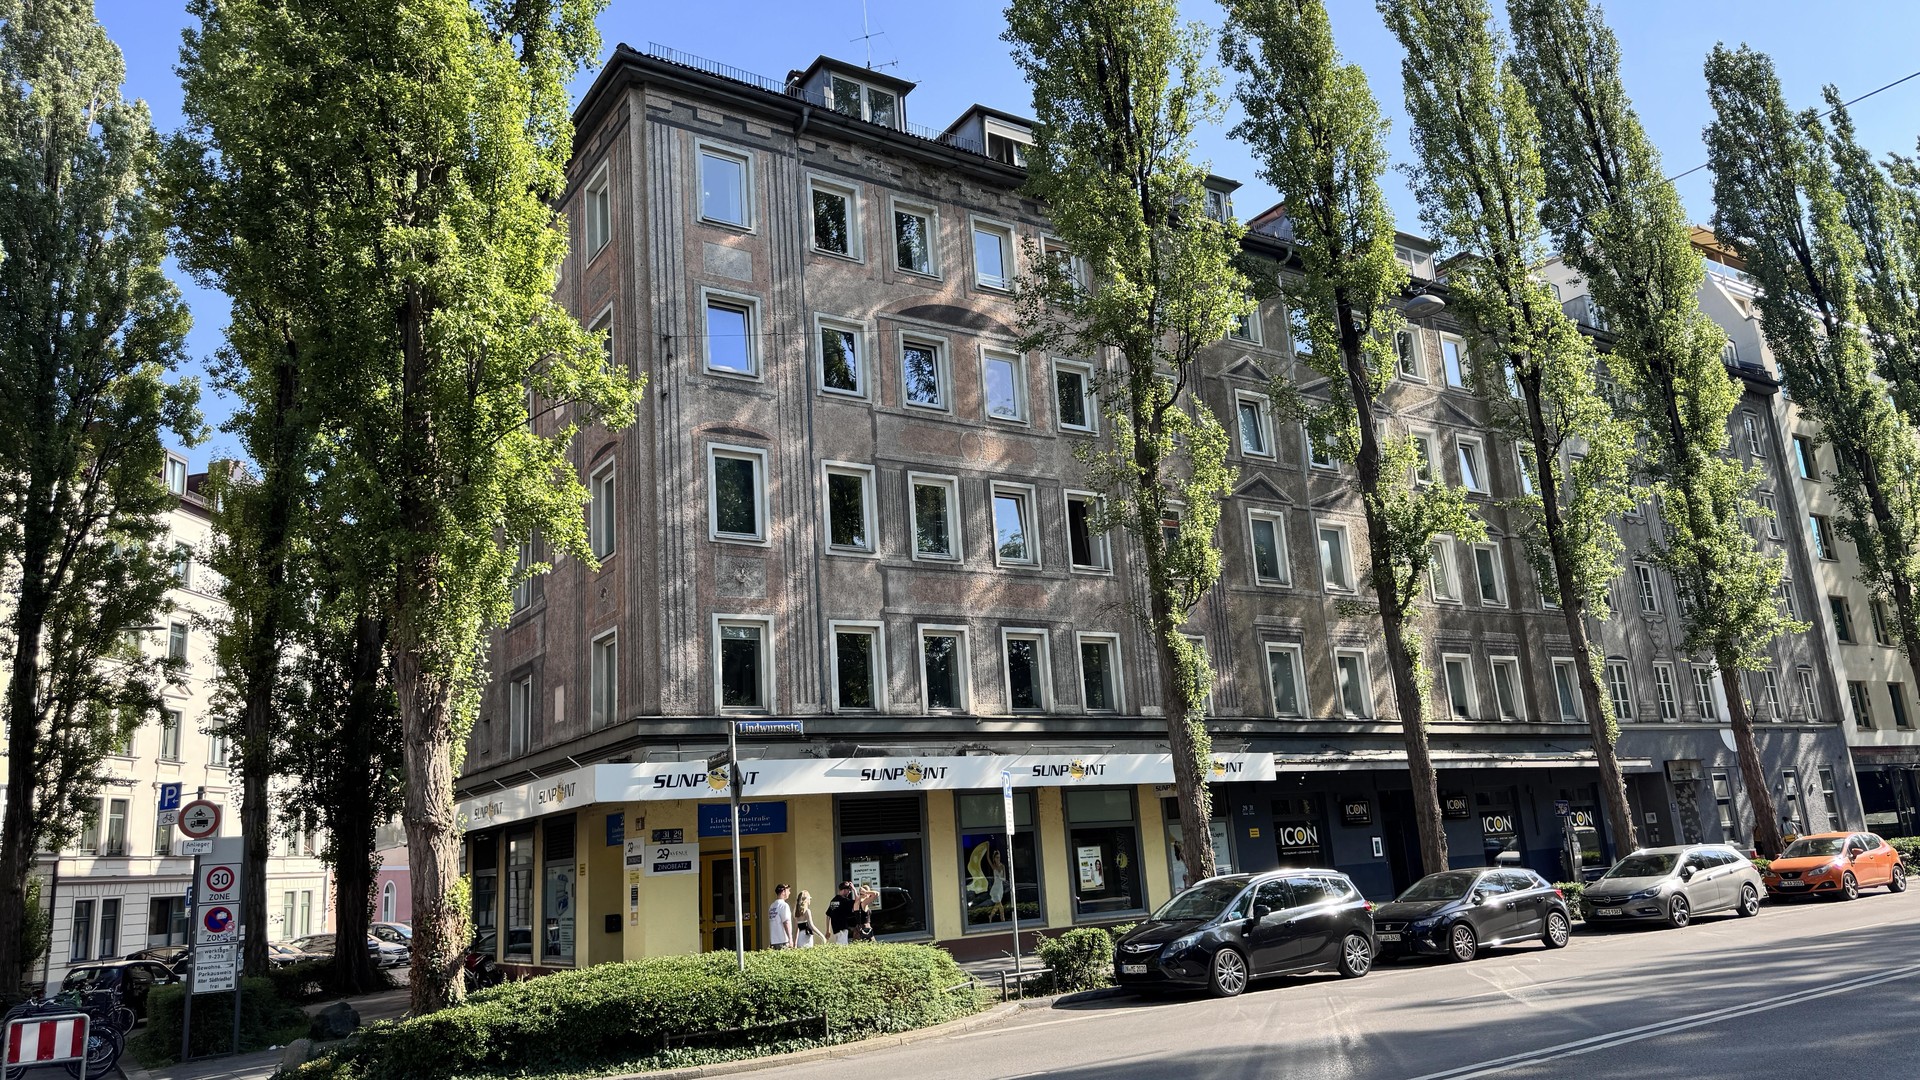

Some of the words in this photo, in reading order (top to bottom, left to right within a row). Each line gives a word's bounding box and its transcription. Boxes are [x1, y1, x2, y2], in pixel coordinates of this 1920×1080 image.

[739, 721, 800, 734] Lindwurmstr.
[860, 762, 948, 784] SUNPOINT
[1032, 762, 1106, 778] SUNPOINT
[164, 785, 178, 807] P
[1345, 804, 1367, 815] ICON
[1446, 799, 1466, 810] ICON
[1482, 815, 1513, 833] ICON
[1280, 826, 1319, 846] ICON
[656, 848, 670, 860] 29
[657, 862, 688, 871] ZINOBEATZ
[212, 873, 229, 886] 30
[209, 893, 231, 901] ZONE
